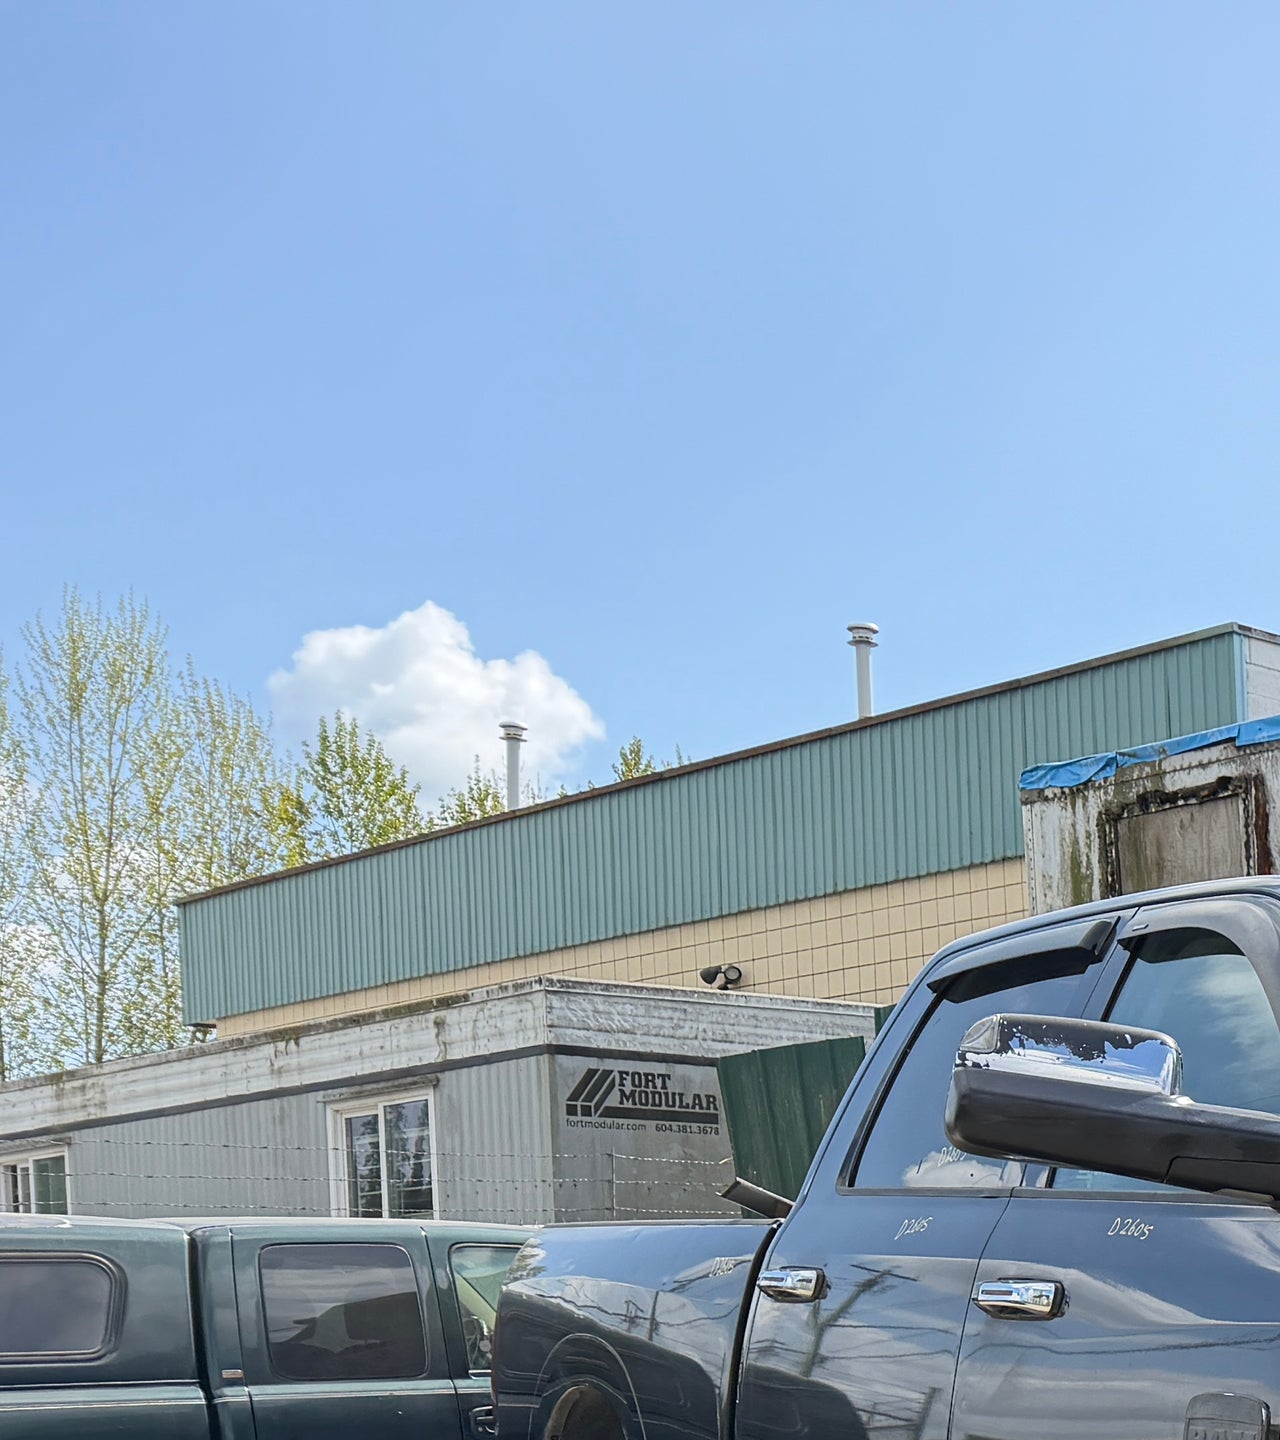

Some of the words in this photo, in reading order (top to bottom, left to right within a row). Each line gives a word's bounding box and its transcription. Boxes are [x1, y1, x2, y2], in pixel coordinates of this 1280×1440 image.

[617, 1070, 671, 1090] FORT
[618, 1089, 719, 1111] MODULAR
[566, 1118, 647, 1132] fortmodular.com
[655, 1123, 720, 1136] 604.381.3678
[1107, 1217, 1154, 1240] D2605
